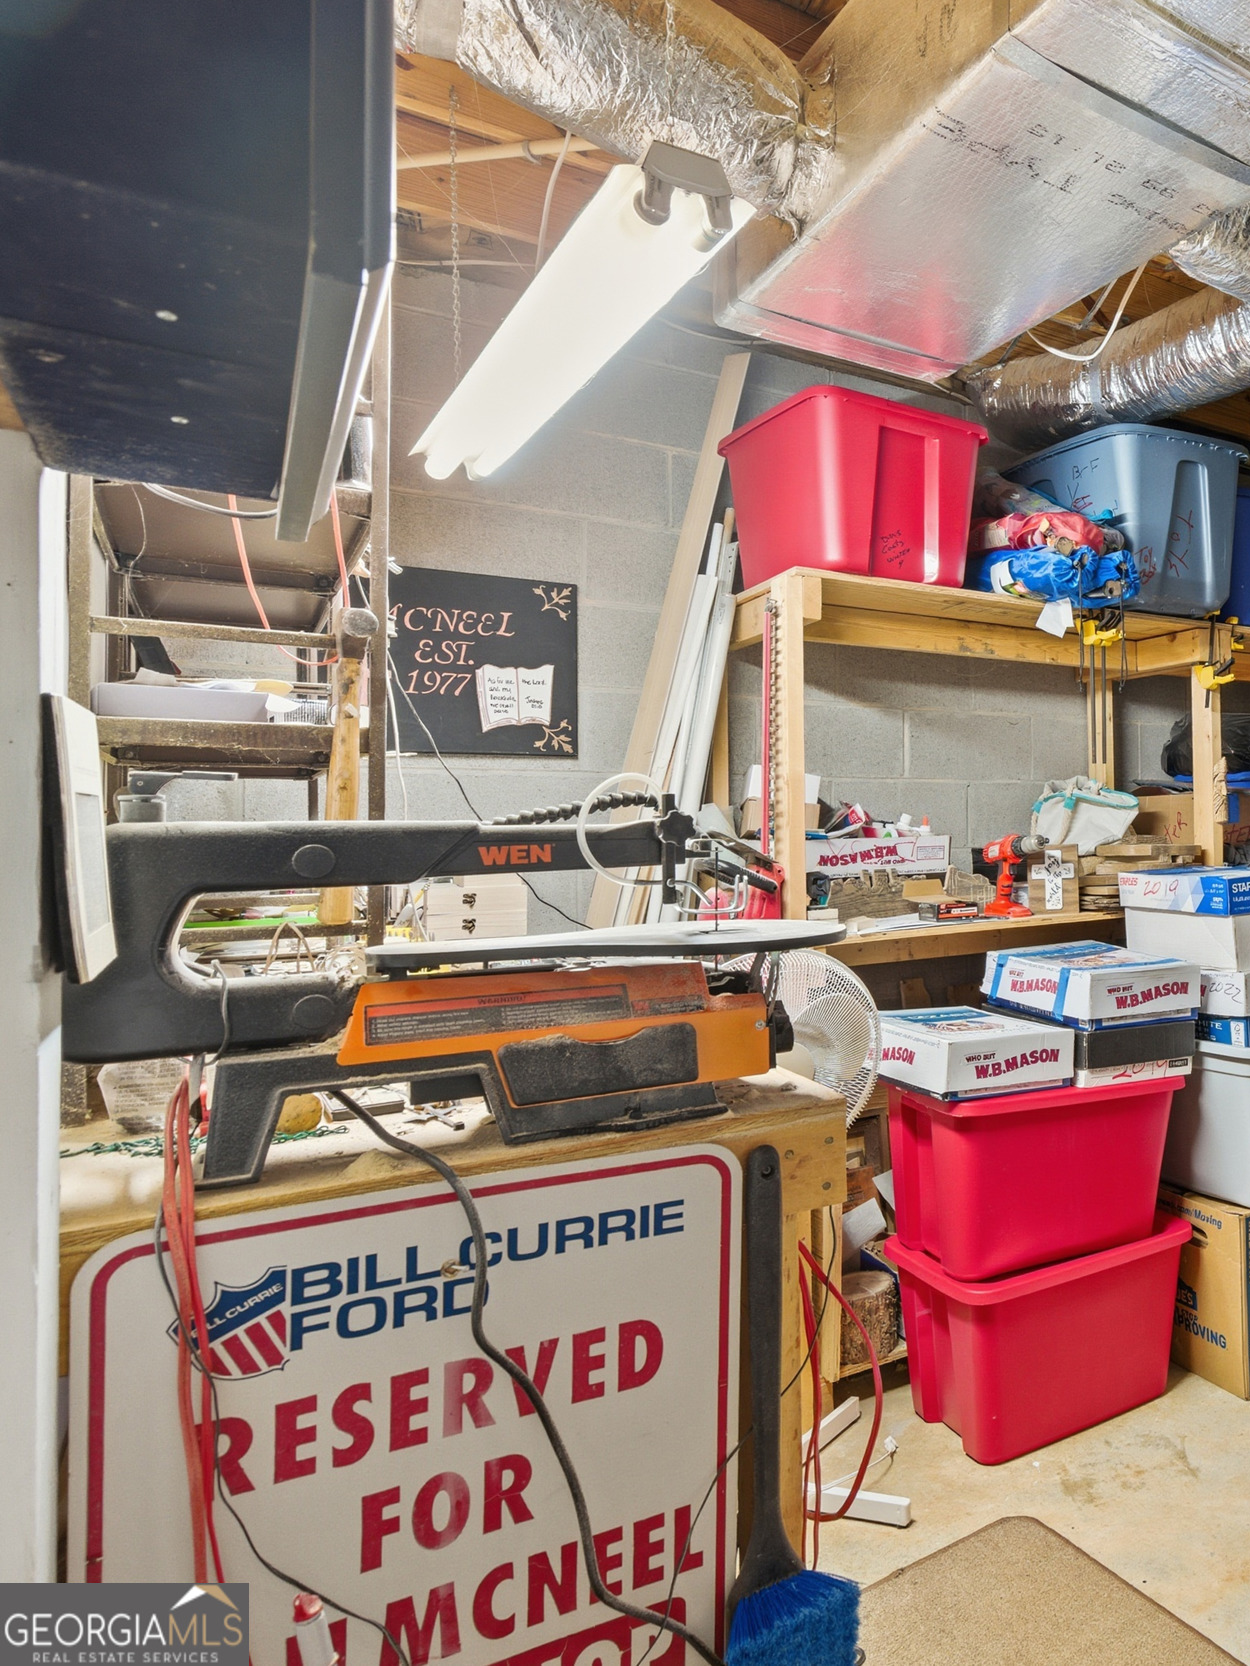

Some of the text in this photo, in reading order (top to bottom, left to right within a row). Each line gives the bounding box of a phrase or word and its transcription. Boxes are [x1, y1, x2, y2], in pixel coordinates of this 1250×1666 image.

[389, 603, 515, 637] CNEEL
[414, 639, 475, 665] EST.
[405, 669, 472, 697] 1977
[478, 844, 552, 866] WEN
[1143, 879, 1178, 897] 2019
[1115, 982, 1189, 1009] W.B.MASON
[1210, 982, 1243, 1004] 2022
[881, 1046, 916, 1066] MASON
[966, 1053, 996, 1063] WHO BUT
[974, 1049, 1060, 1079] W.B.MASON
[291, 1199, 685, 1306] BILL CURRIE
[225, 1282, 284, 1319] CURRIE
[290, 1276, 489, 1351] FORD
[195, 1319, 664, 1496] RESERVED
[360, 1453, 534, 1574] FOR
[381, 1504, 704, 1666] MCNEEL
